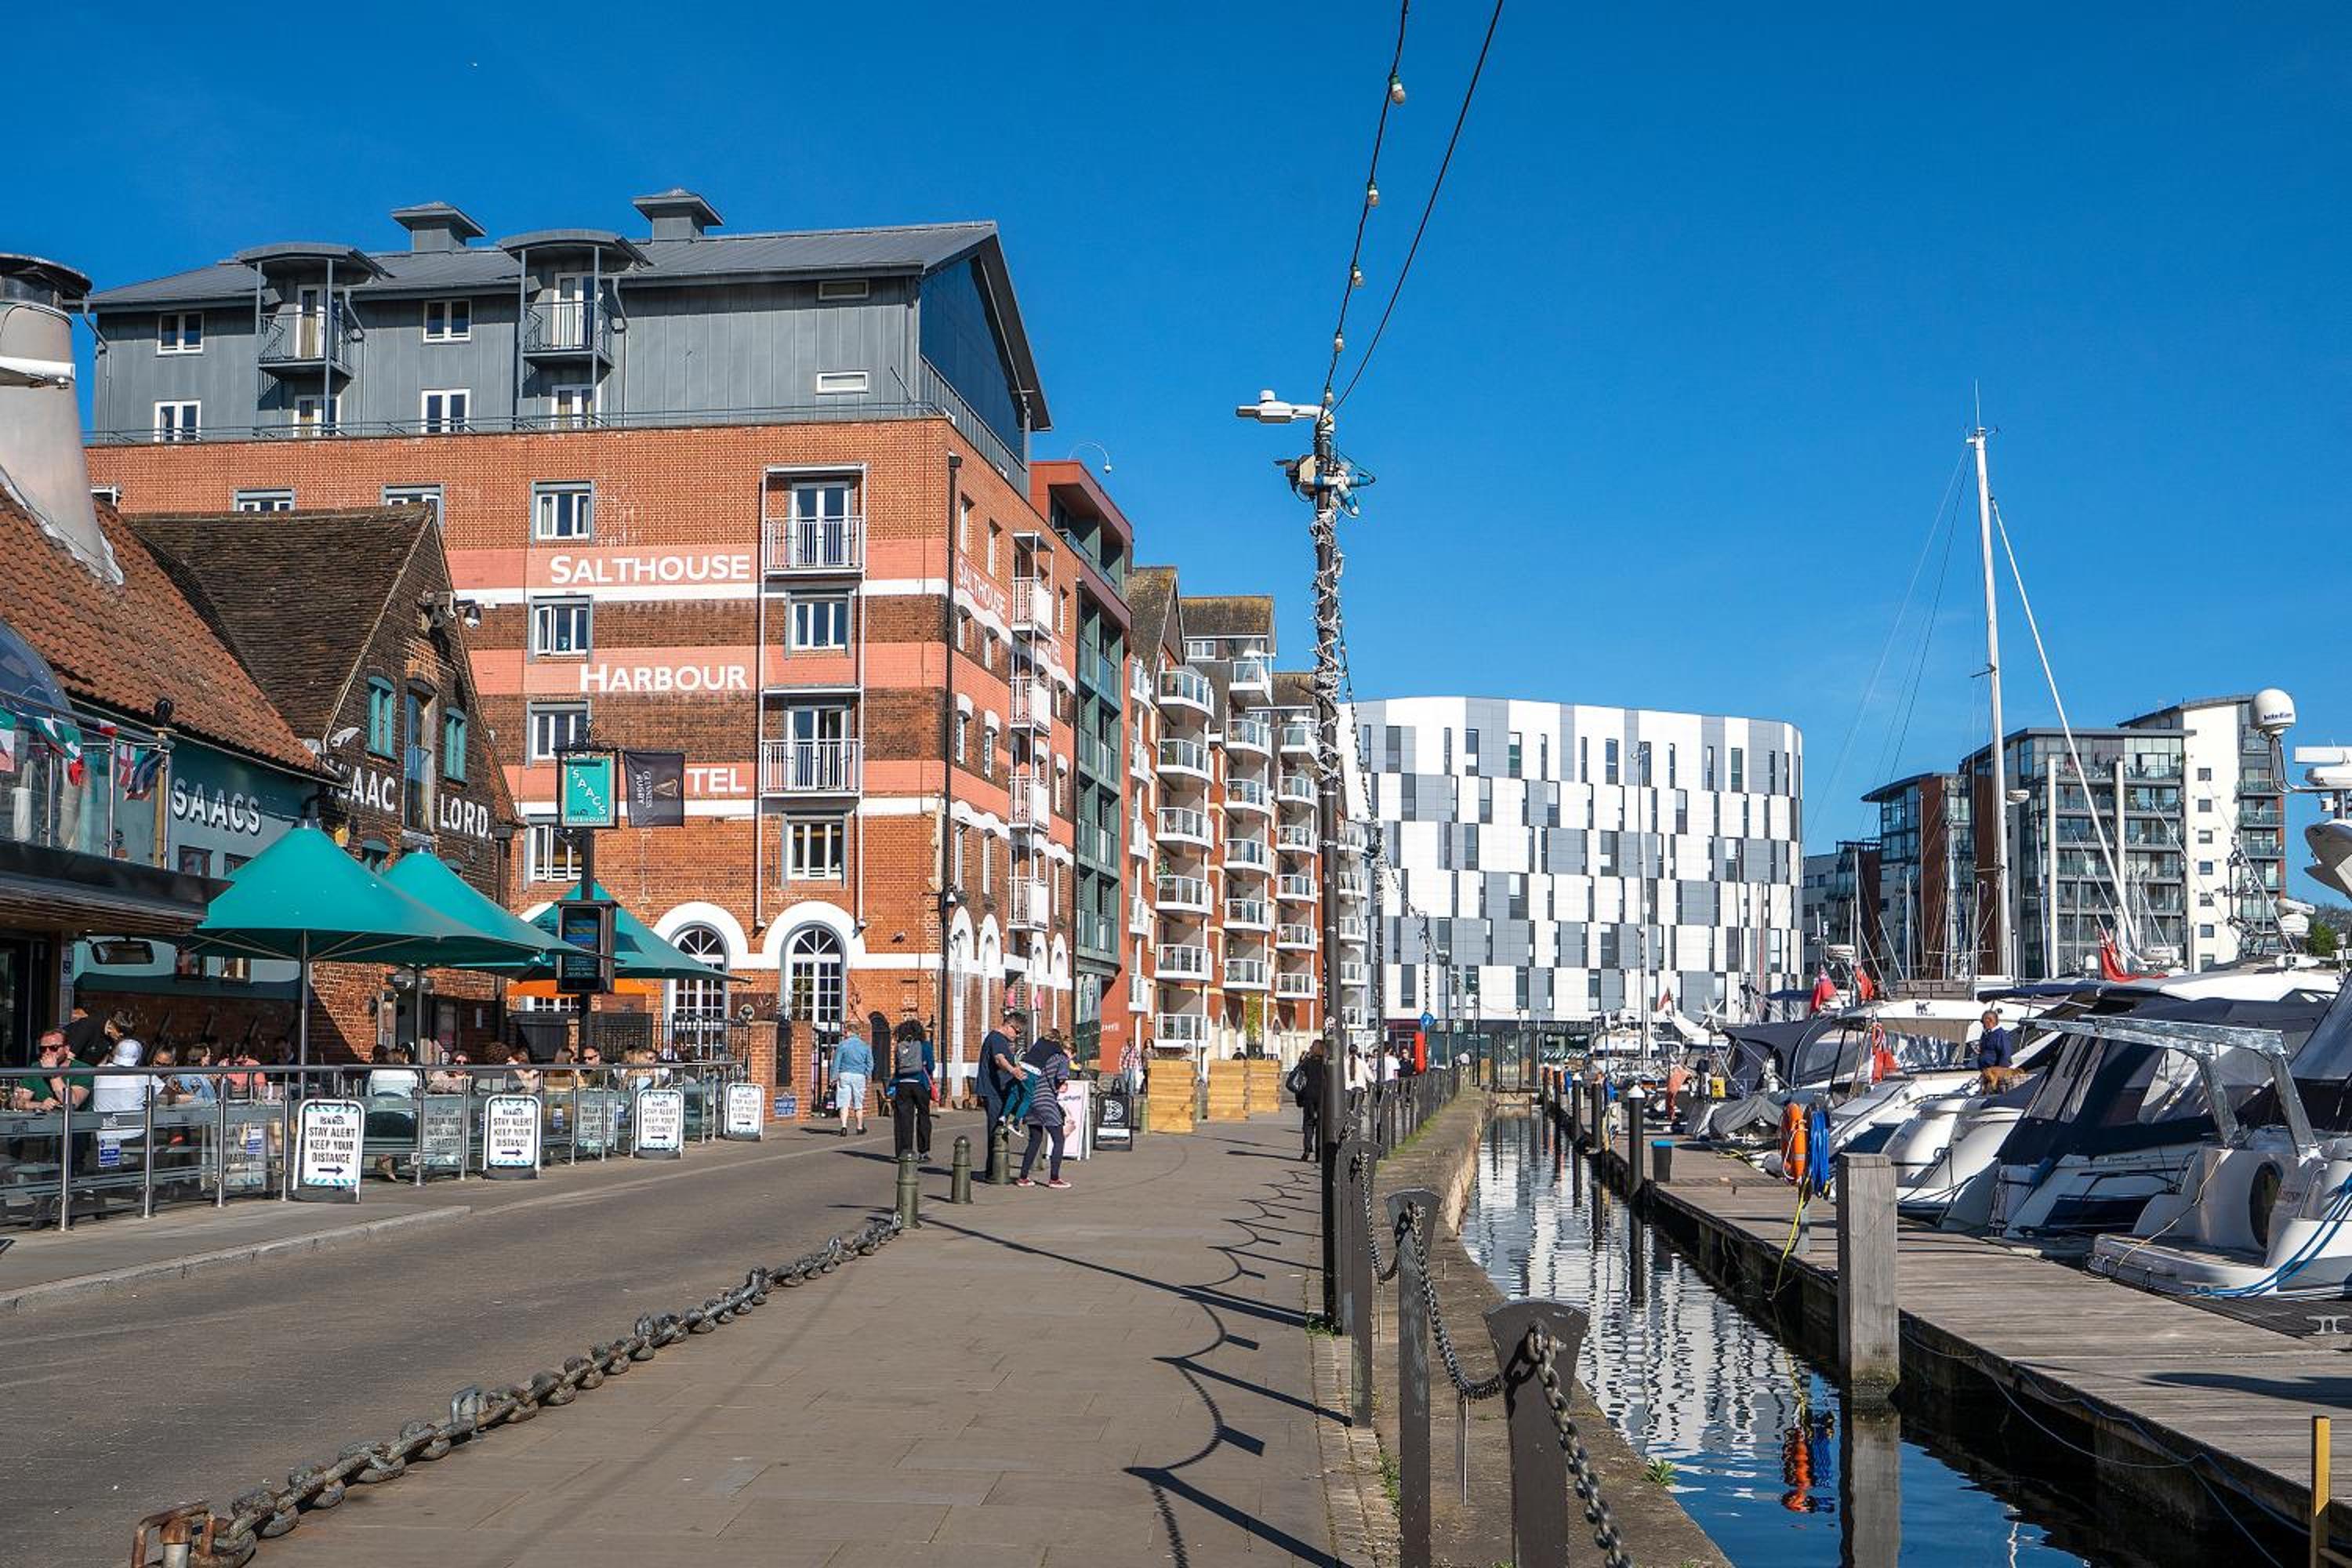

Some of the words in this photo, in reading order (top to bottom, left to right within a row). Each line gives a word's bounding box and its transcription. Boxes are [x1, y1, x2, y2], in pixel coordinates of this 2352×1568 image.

[550, 554, 750, 584] SALTHOUSE
[957, 556, 1006, 619] SALTHOUSE
[579, 663, 749, 692] HARBOUR
[308, 1127, 328, 1137] STAY
[331, 1128, 356, 1138] ALERT
[310, 1140, 330, 1150] KEEP
[333, 1142, 354, 1151] YOUR
[311, 1152, 351, 1163] DISTANCE
